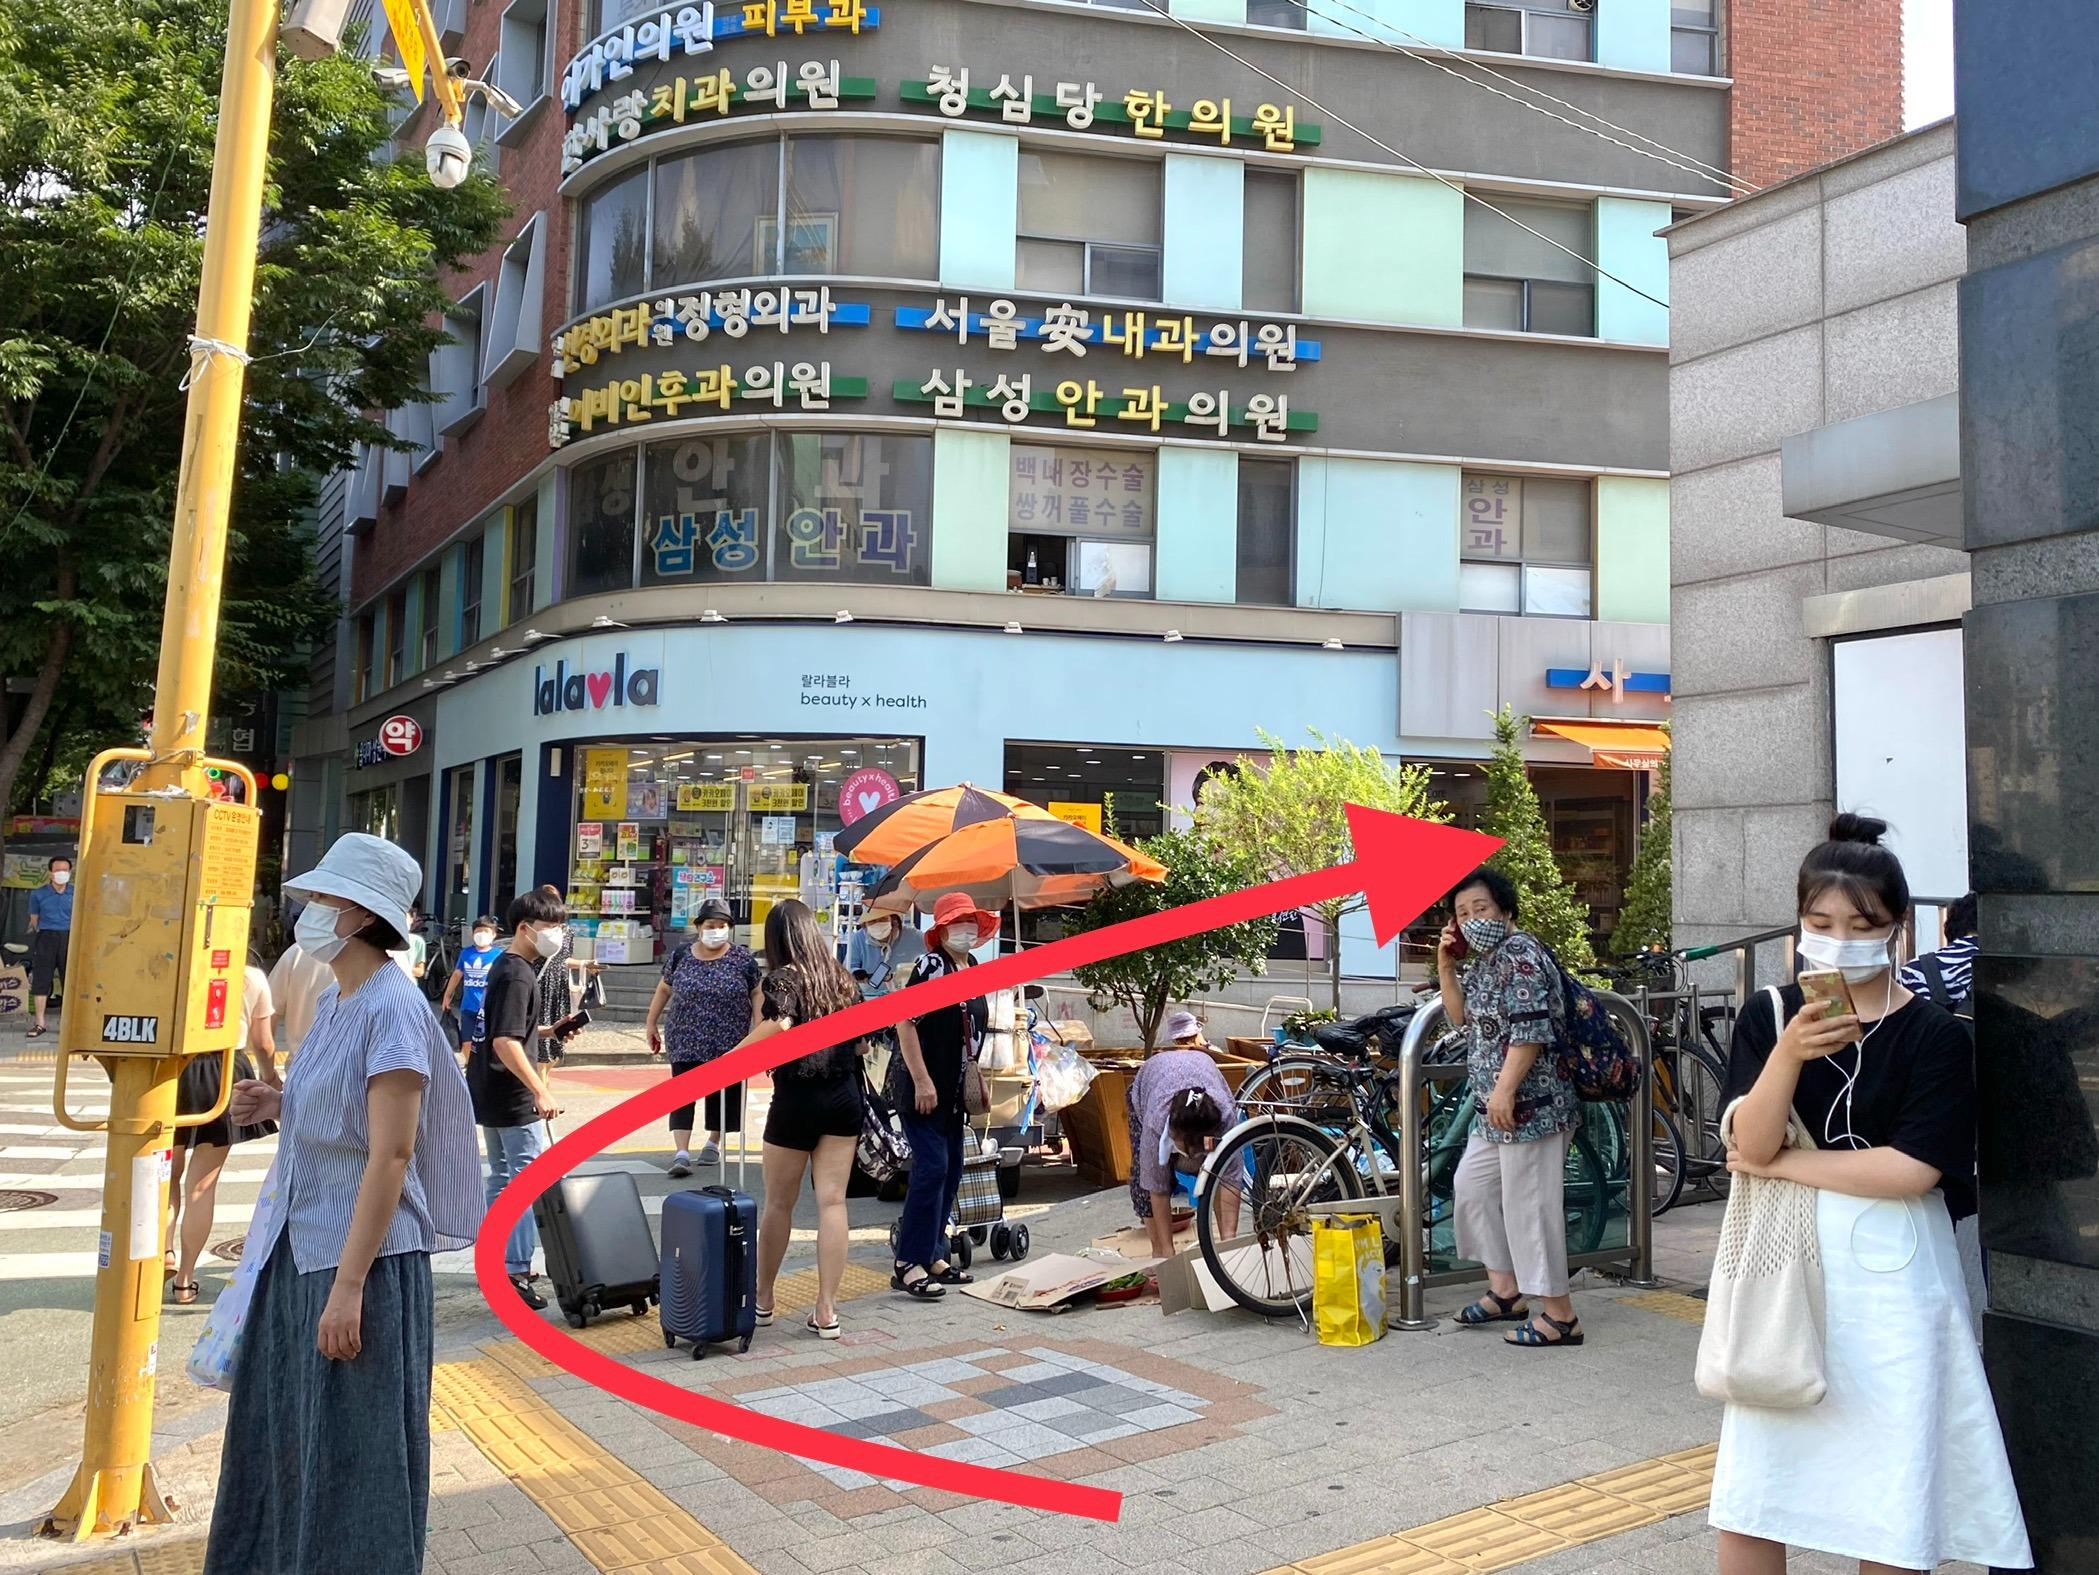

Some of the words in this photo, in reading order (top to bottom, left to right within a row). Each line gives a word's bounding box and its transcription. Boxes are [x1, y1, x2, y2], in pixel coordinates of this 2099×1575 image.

[742, 0, 866, 37] 피부과
[675, 286, 836, 341] 정형외과
[801, 674, 851, 689] 랄라블라
[800, 692, 858, 709] beauty
[861, 696, 871, 707] x
[876, 694, 927, 708] health
[384, 720, 417, 752] 약
[103, 1016, 157, 1042] 4BLK
